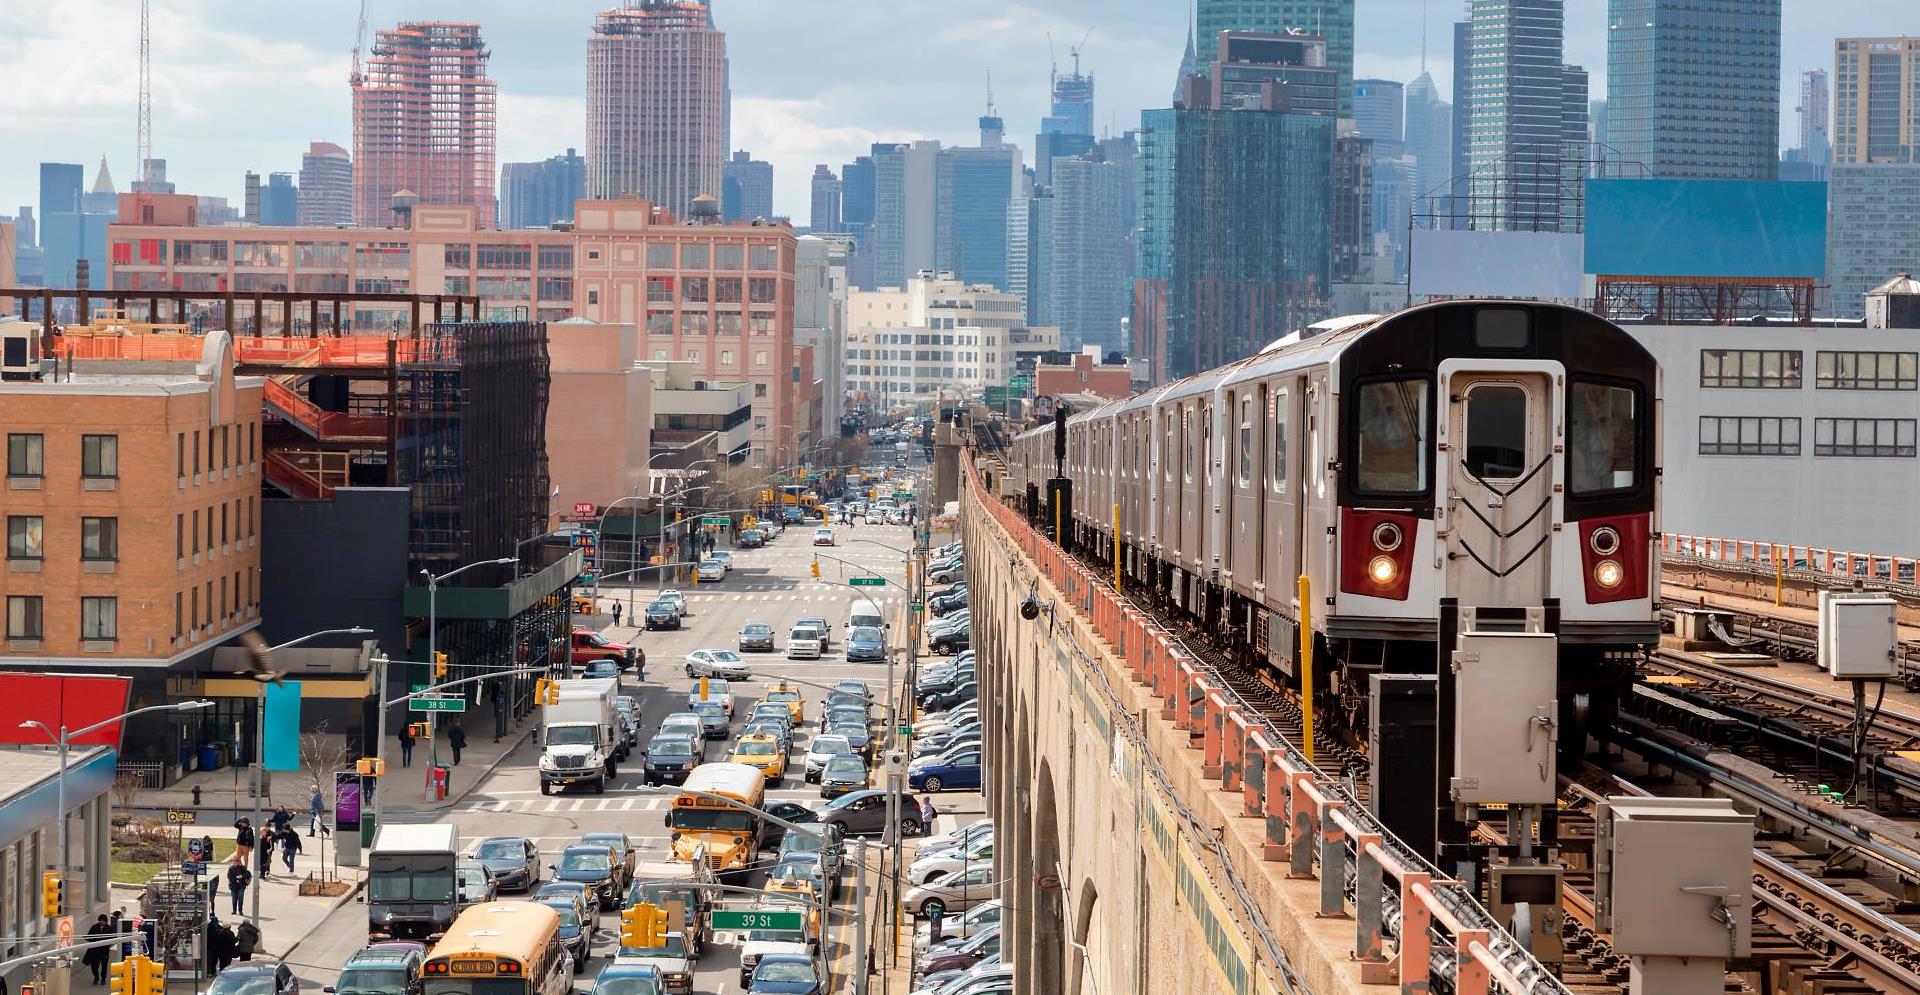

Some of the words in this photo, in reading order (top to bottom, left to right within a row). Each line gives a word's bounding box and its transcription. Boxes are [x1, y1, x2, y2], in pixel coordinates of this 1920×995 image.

[428, 701, 437, 709] 38
[439, 701, 446, 709] St
[742, 914, 756, 927] 39
[760, 914, 772, 927] St
[451, 961, 479, 973] SCHOOL
[480, 961, 494, 973] BUS
